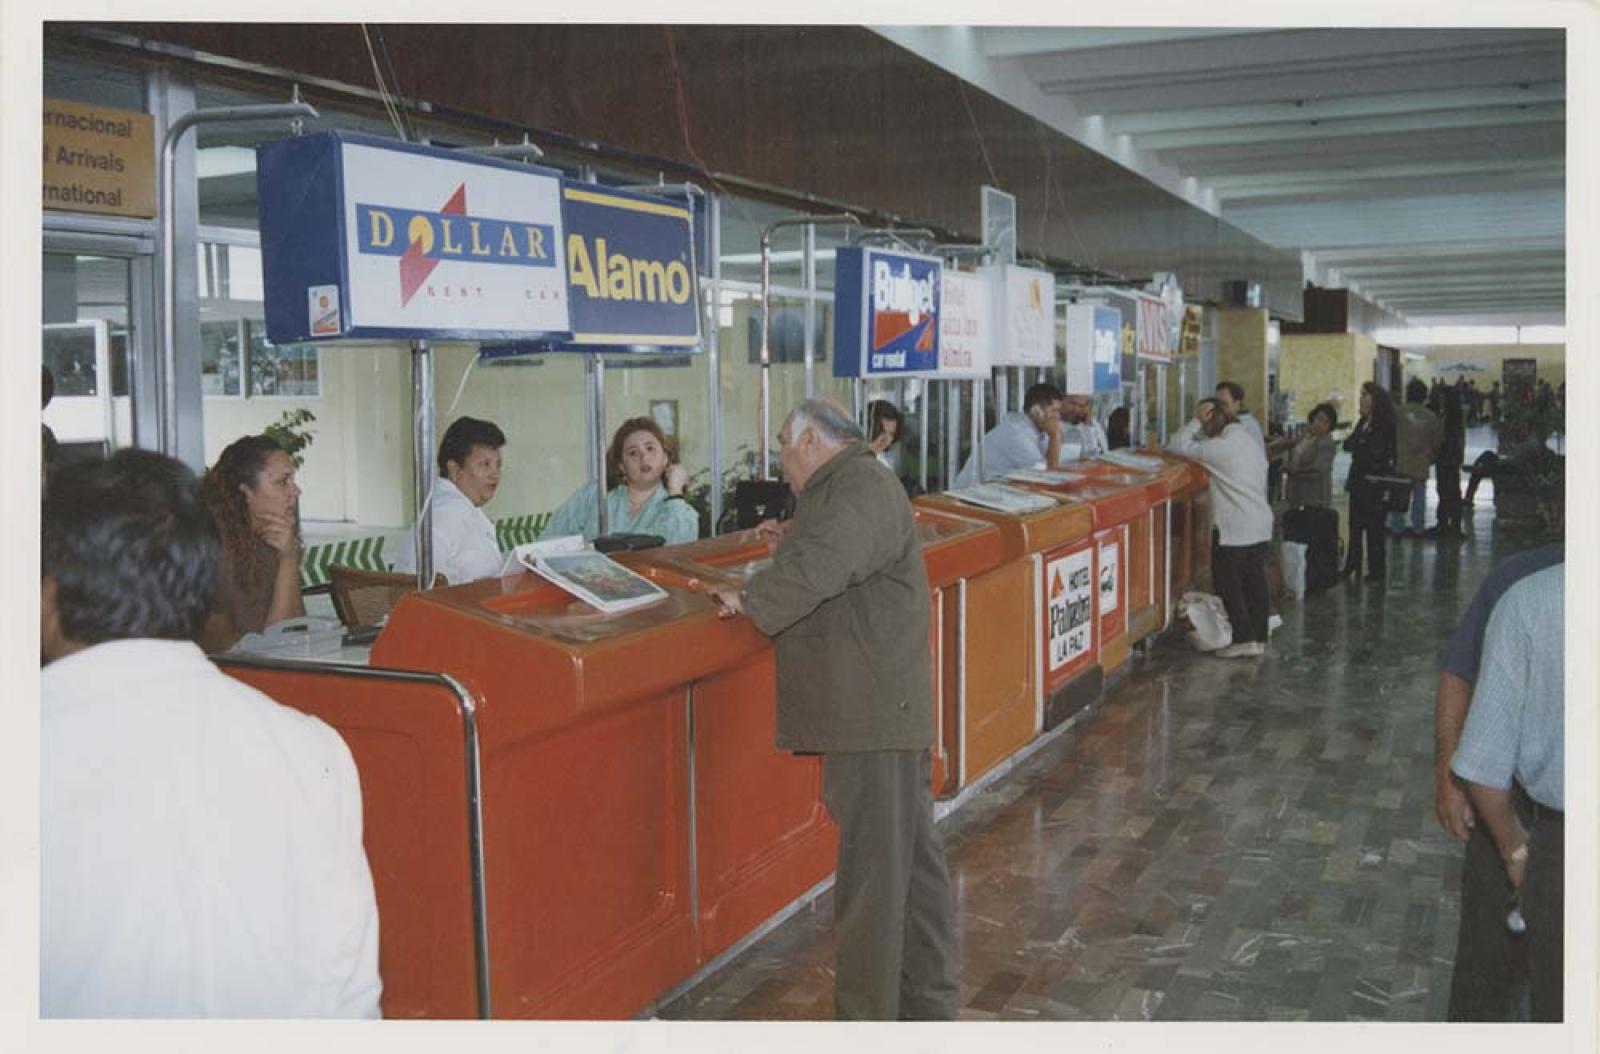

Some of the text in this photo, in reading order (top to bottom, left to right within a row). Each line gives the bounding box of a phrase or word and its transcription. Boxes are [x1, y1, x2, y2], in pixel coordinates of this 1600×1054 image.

[56, 145, 125, 172] Arrivals
[368, 210, 548, 259] DOLLAR
[567, 233, 690, 305] Alamo
[874, 260, 936, 326] Budget
